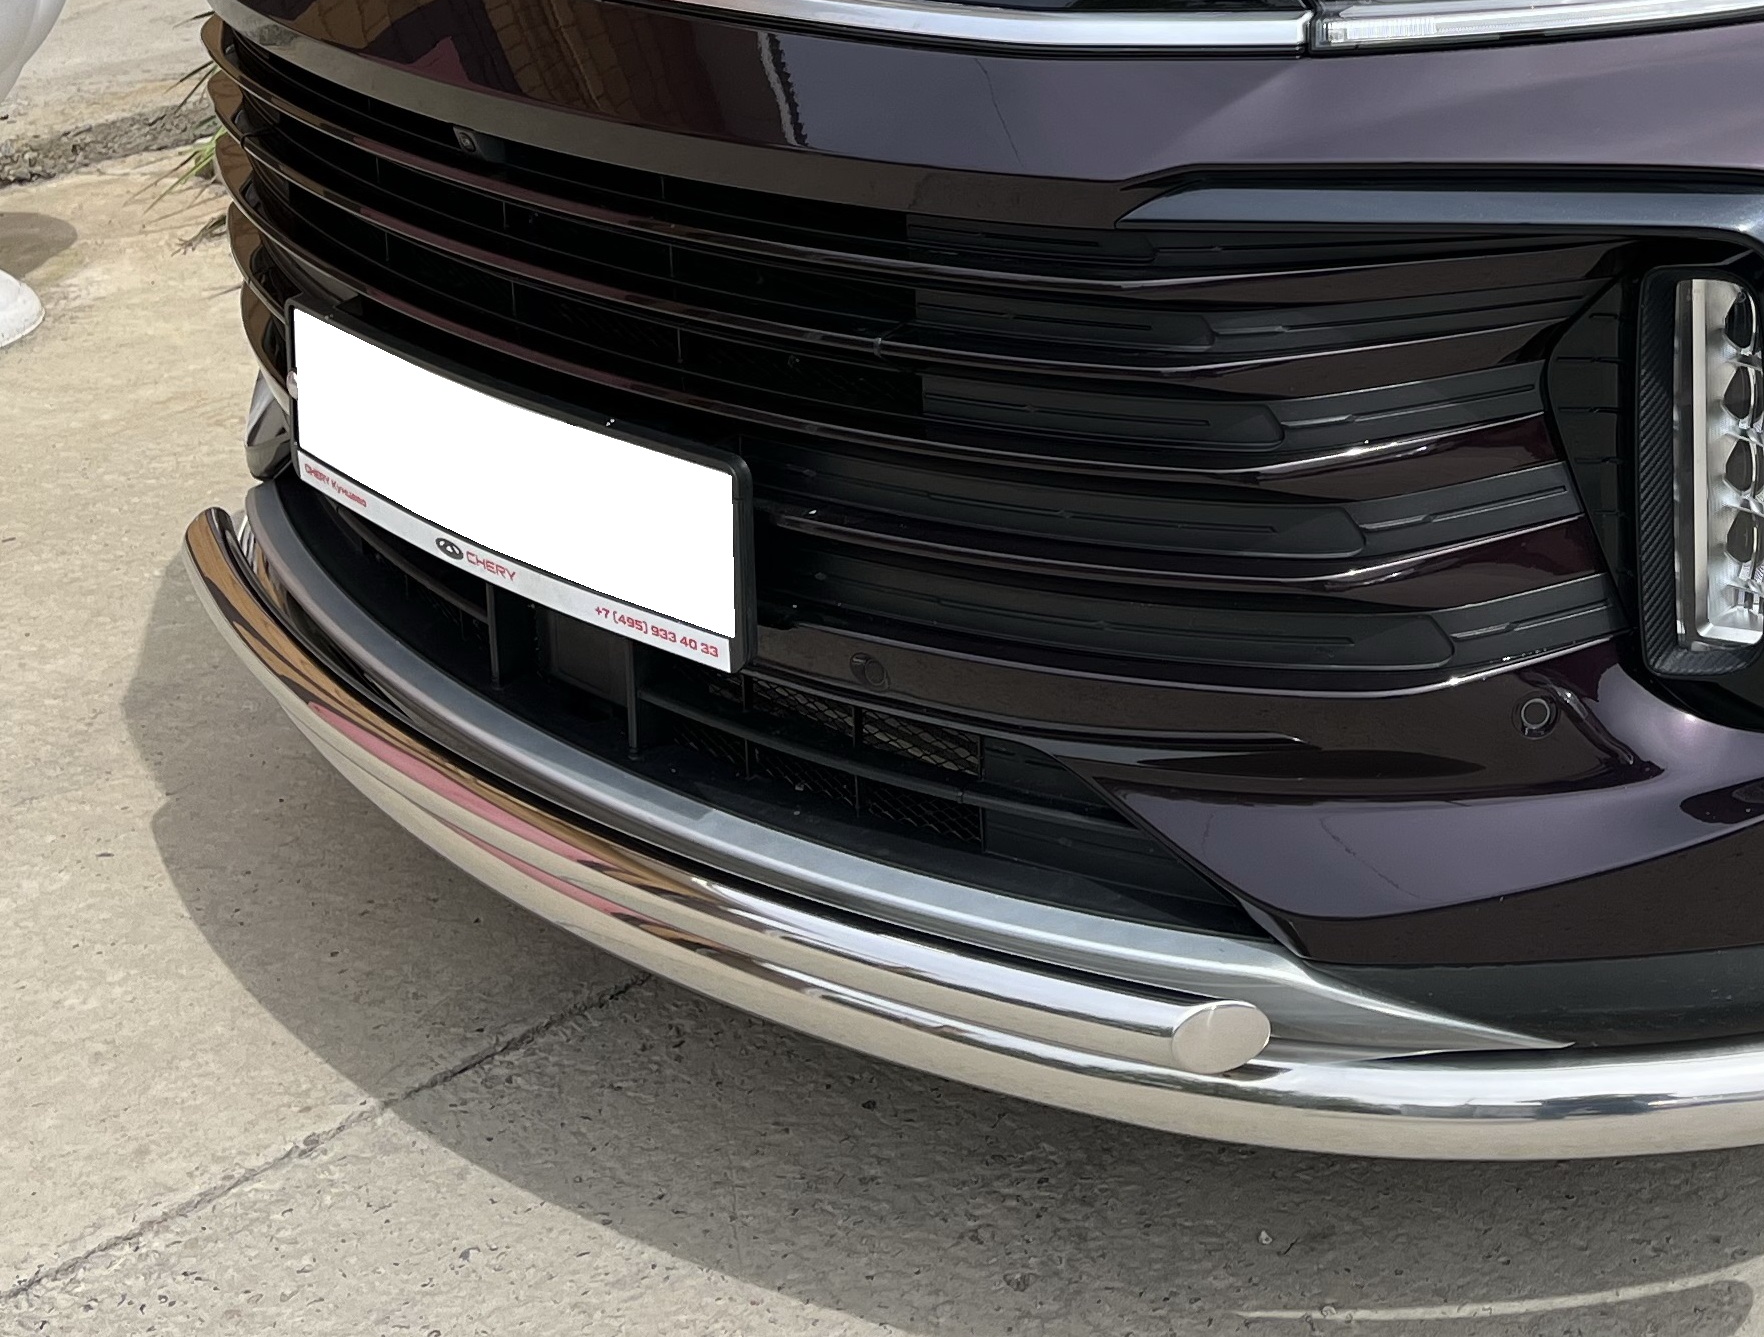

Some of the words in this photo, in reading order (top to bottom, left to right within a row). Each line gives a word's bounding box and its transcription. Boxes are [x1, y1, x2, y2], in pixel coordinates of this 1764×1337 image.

[466, 550, 516, 582] CHERY
[595, 606, 610, 619] +7
[612, 610, 648, 634] (495)
[651, 625, 677, 643] 933
[680, 636, 697, 651] 40
[700, 642, 719, 658] 33
